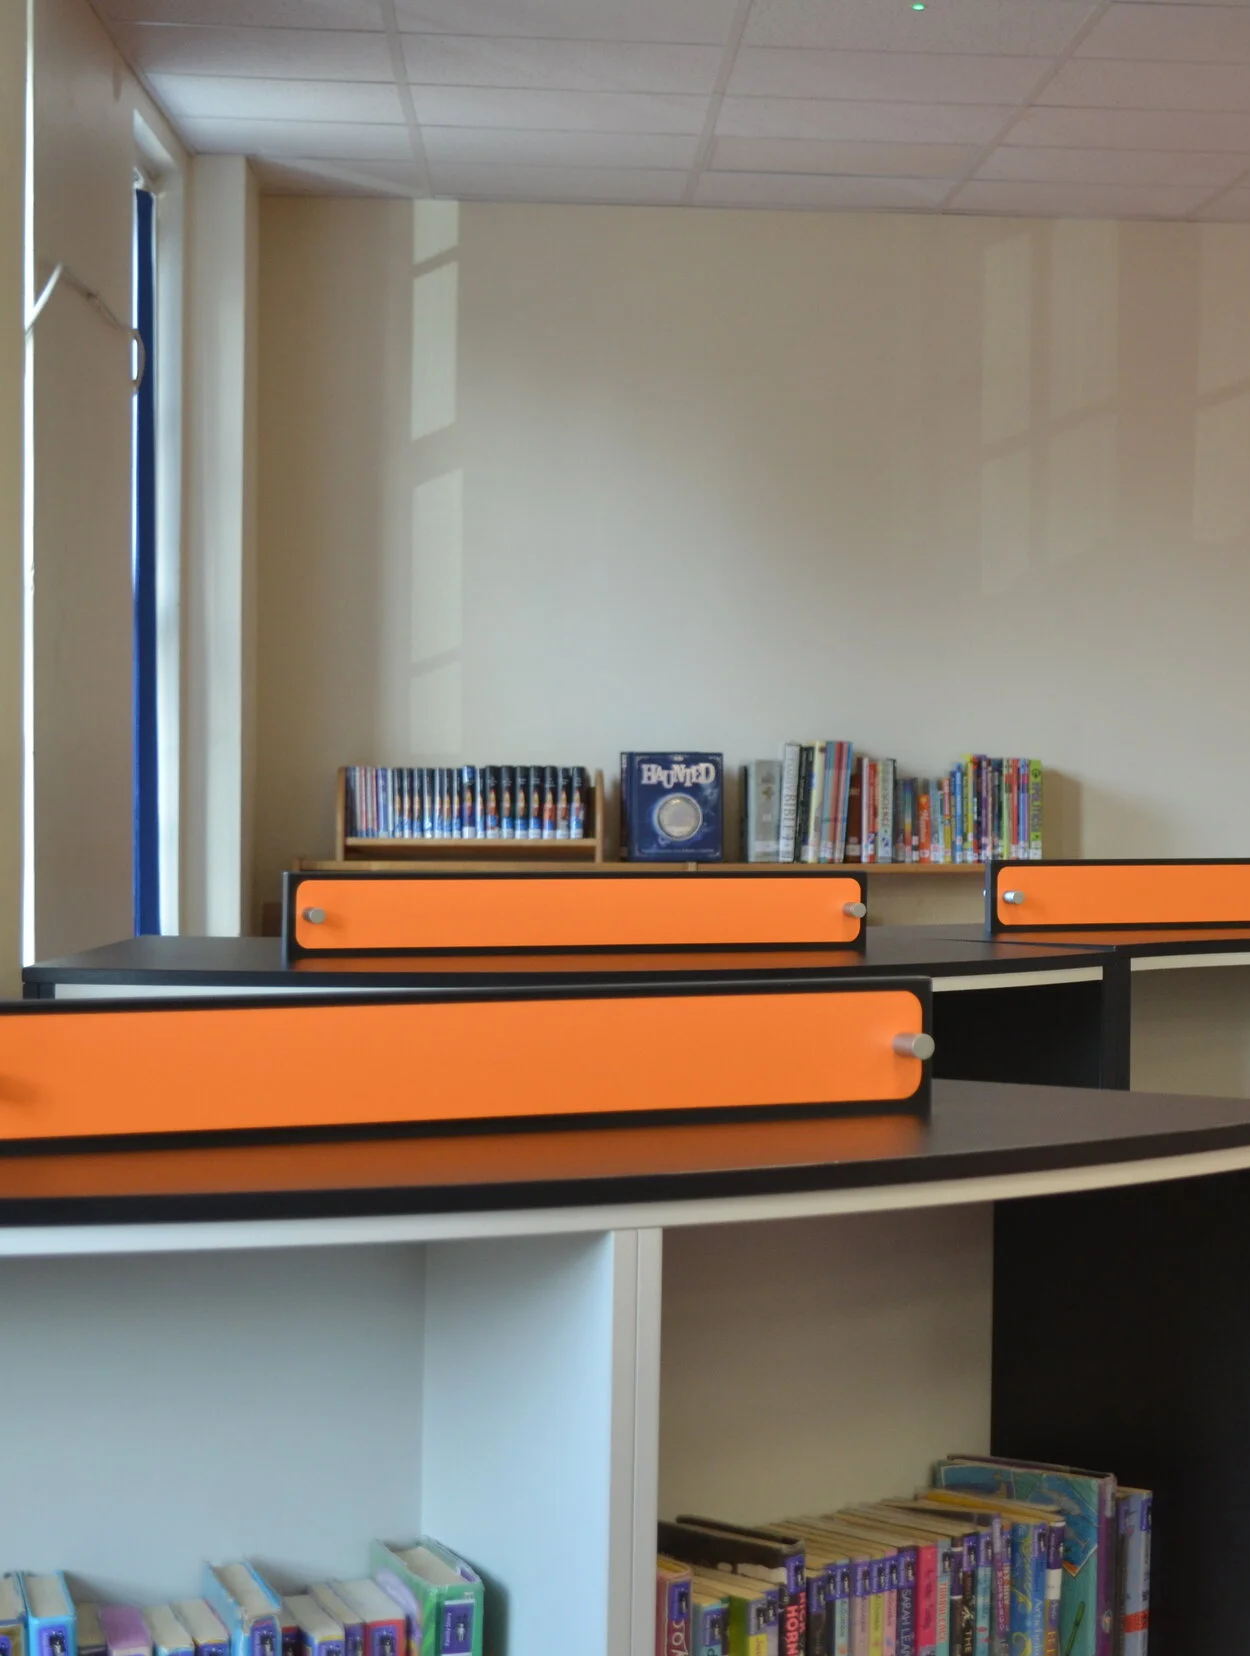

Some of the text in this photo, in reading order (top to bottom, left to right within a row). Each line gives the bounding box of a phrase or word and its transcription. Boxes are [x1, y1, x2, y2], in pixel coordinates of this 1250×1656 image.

[641, 763, 716, 789] HAUNTED
[901, 1588, 911, 1625] SARAH
[785, 1605, 800, 1656] HORN
[964, 1630, 972, 1654] THE
